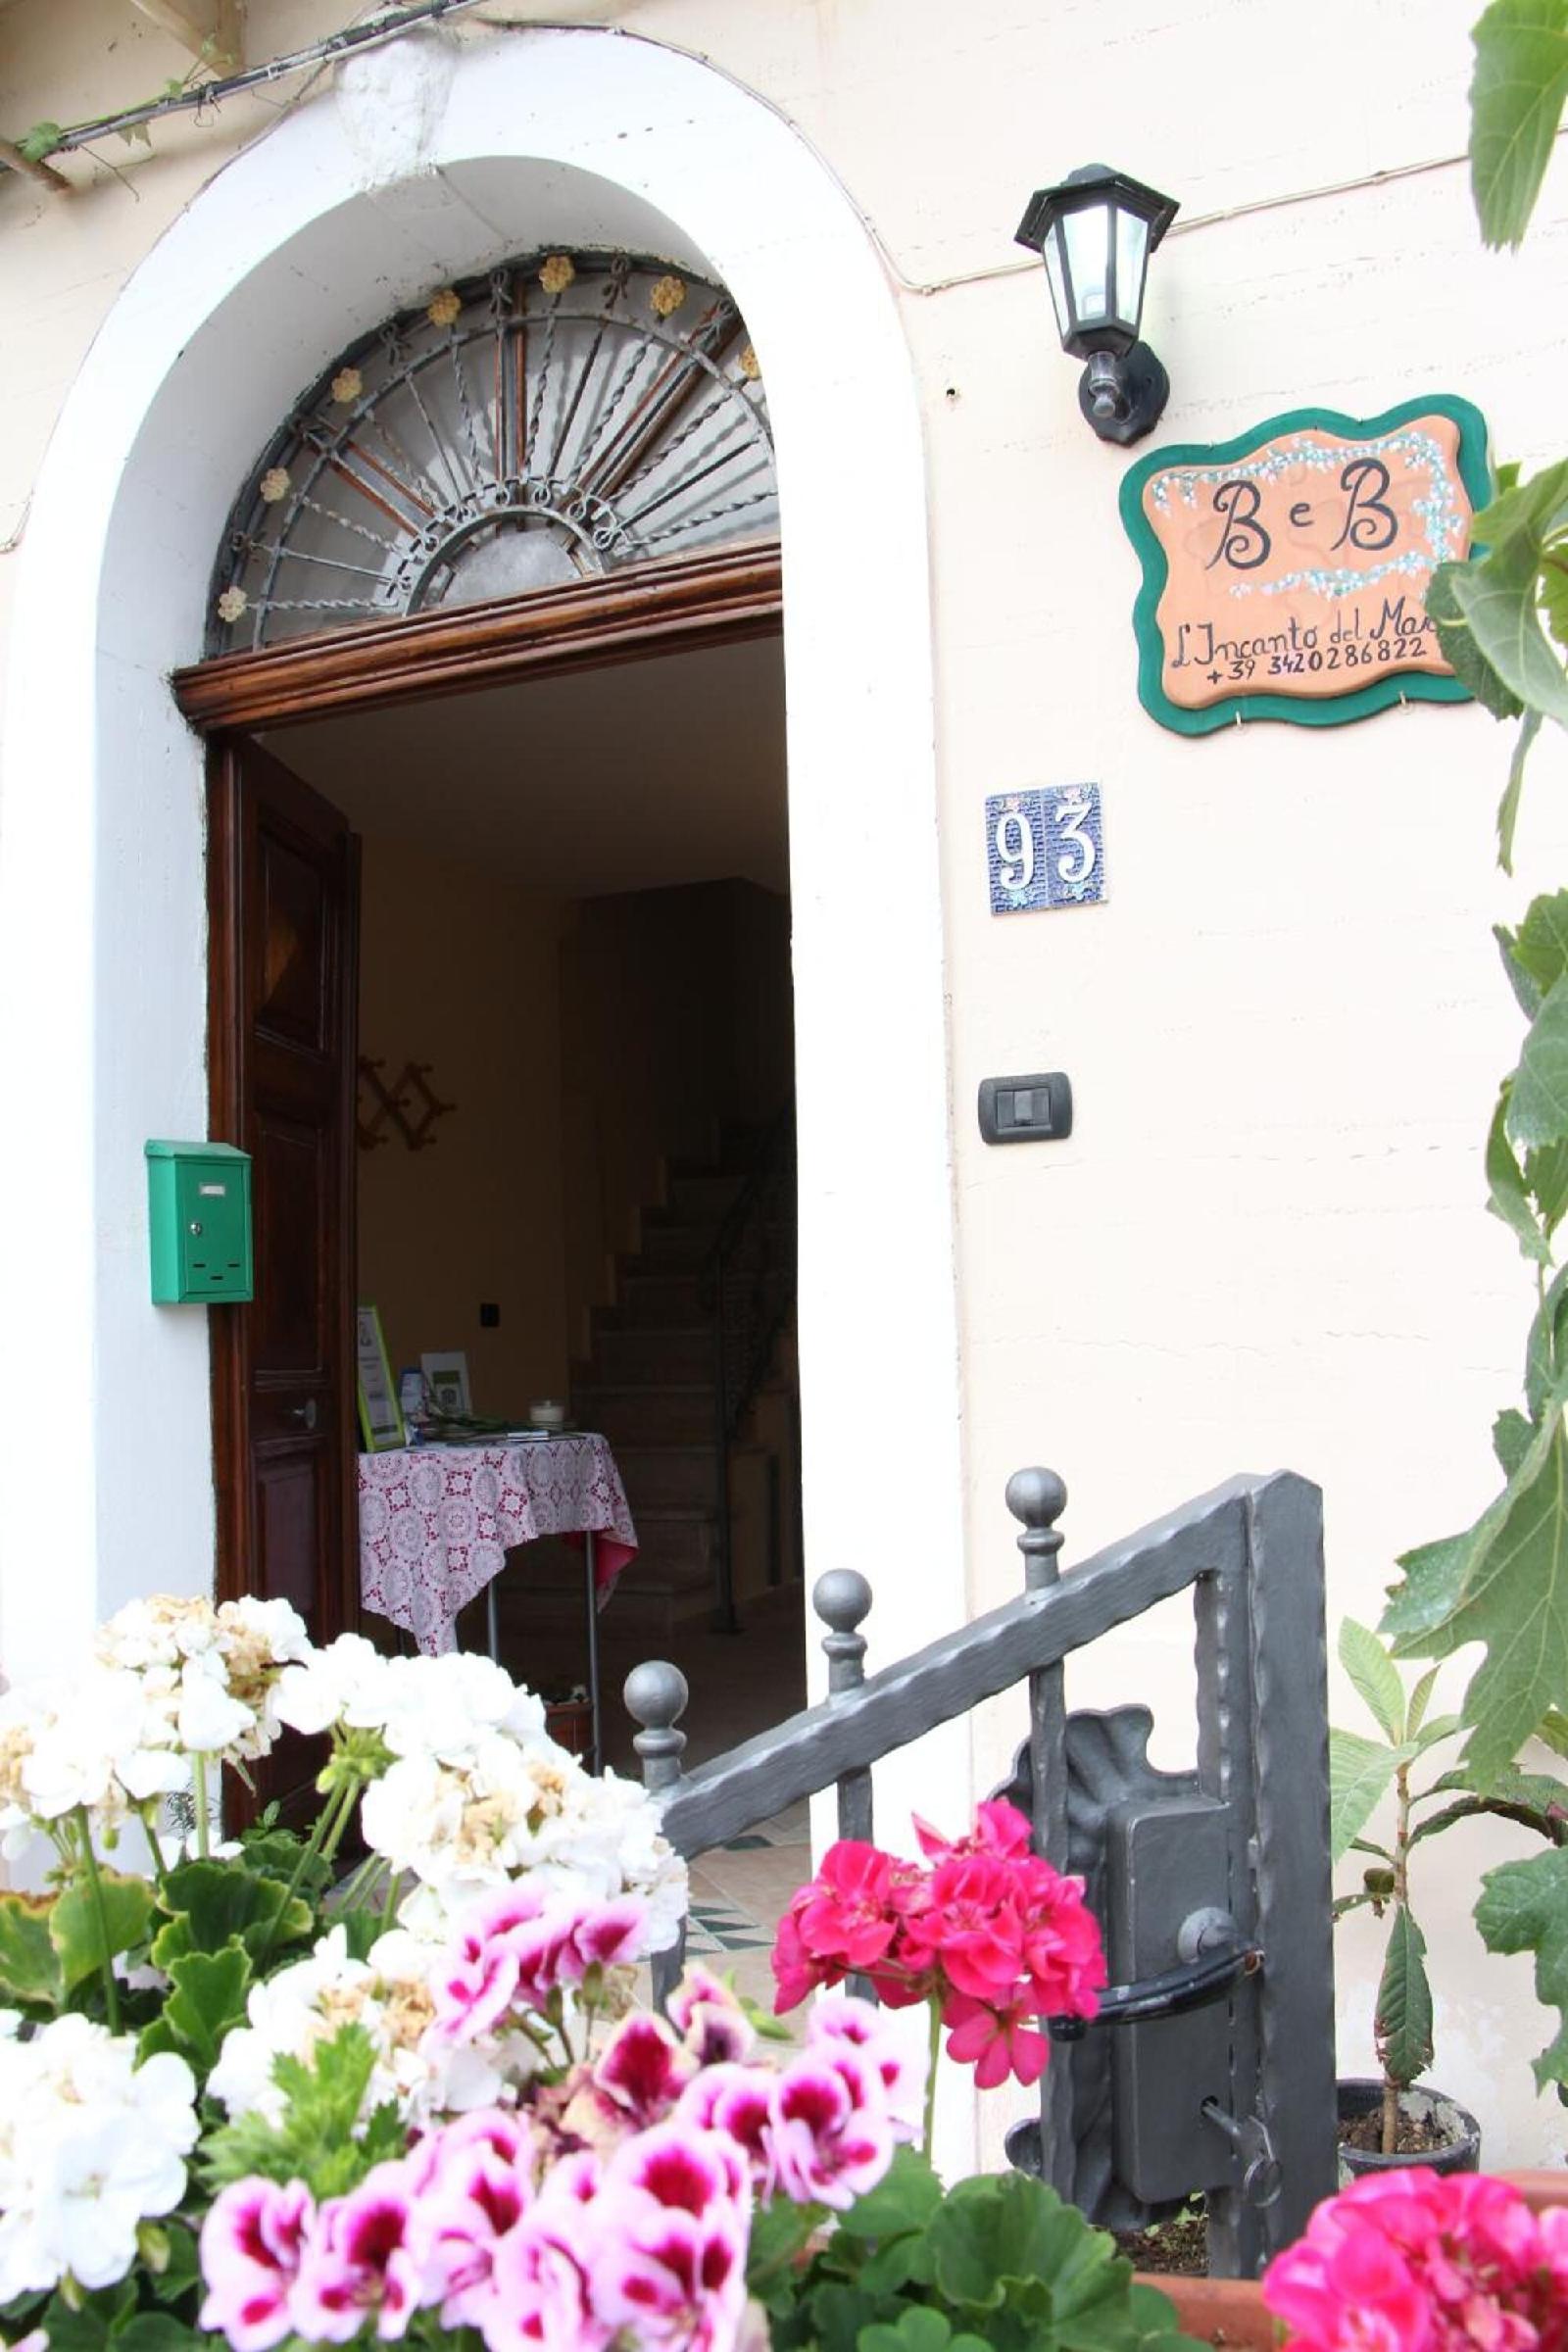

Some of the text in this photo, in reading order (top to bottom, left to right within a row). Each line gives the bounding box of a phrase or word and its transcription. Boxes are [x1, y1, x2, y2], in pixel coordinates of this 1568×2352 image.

[1204, 457, 1398, 570] B e B
[1330, 608, 1363, 644] del
[1370, 596, 1437, 640] Mar
[1267, 636, 1427, 675] 3420286822
[996, 802, 1097, 891] 93
